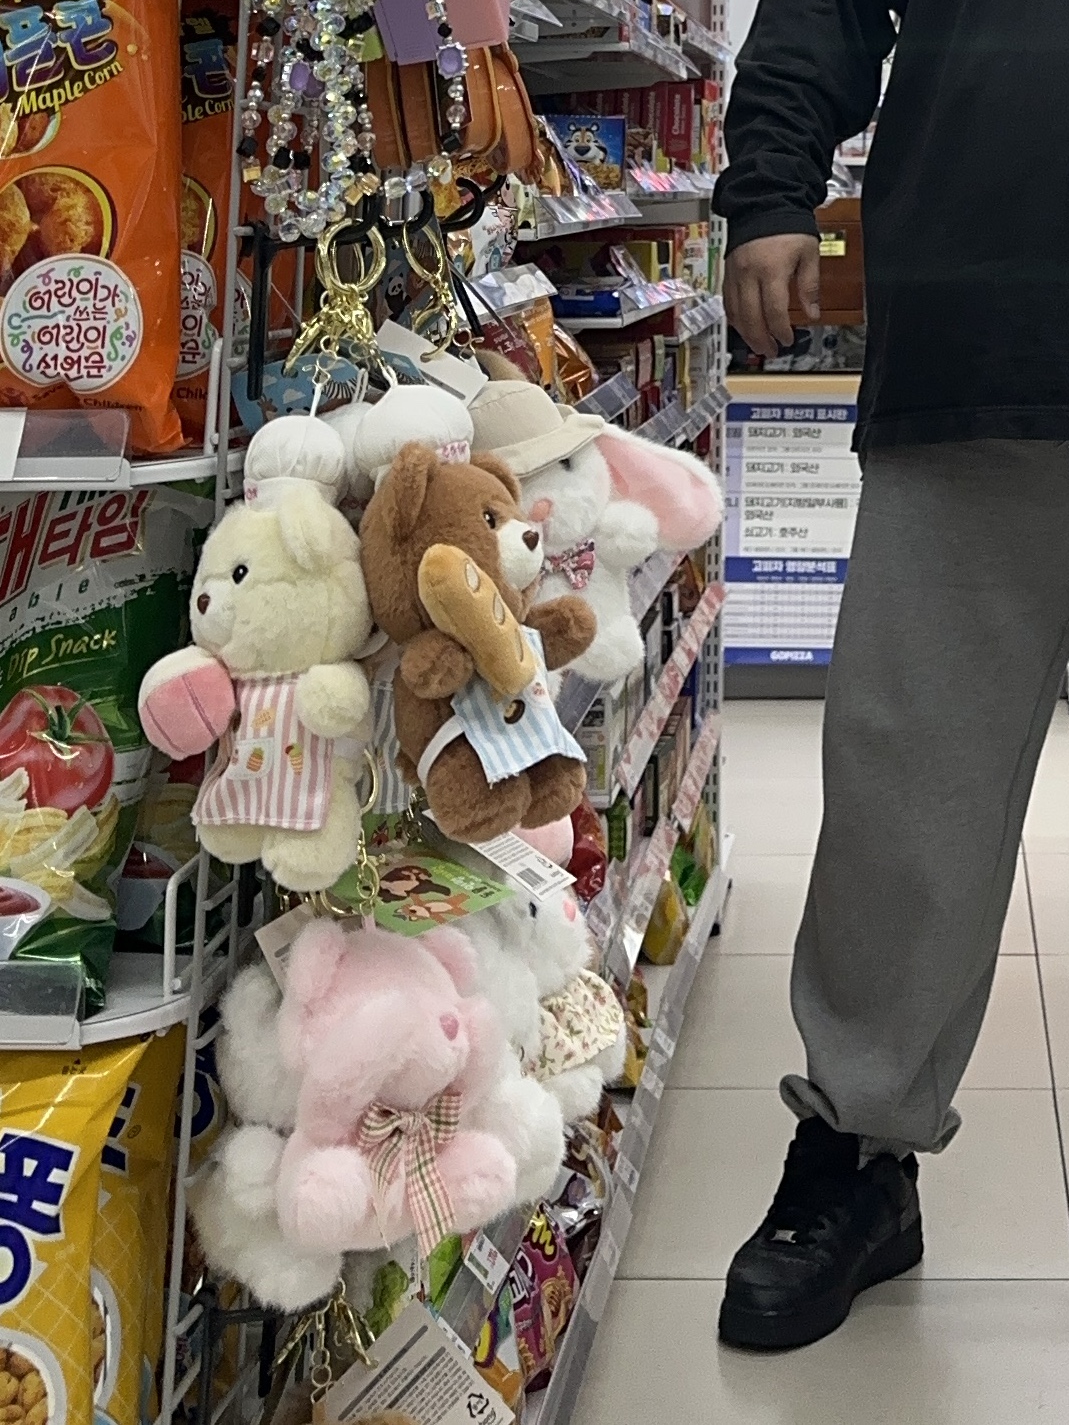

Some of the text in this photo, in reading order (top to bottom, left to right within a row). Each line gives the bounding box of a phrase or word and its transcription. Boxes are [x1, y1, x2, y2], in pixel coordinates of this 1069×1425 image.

[18, 58, 124, 117] Maple Corn
[205, 98, 235, 117] Corn
[28, 277, 121, 312] 어린이가
[37, 323, 107, 353] 어린이
[37, 351, 107, 382] 선언문
[41, 628, 117, 665] Snack
